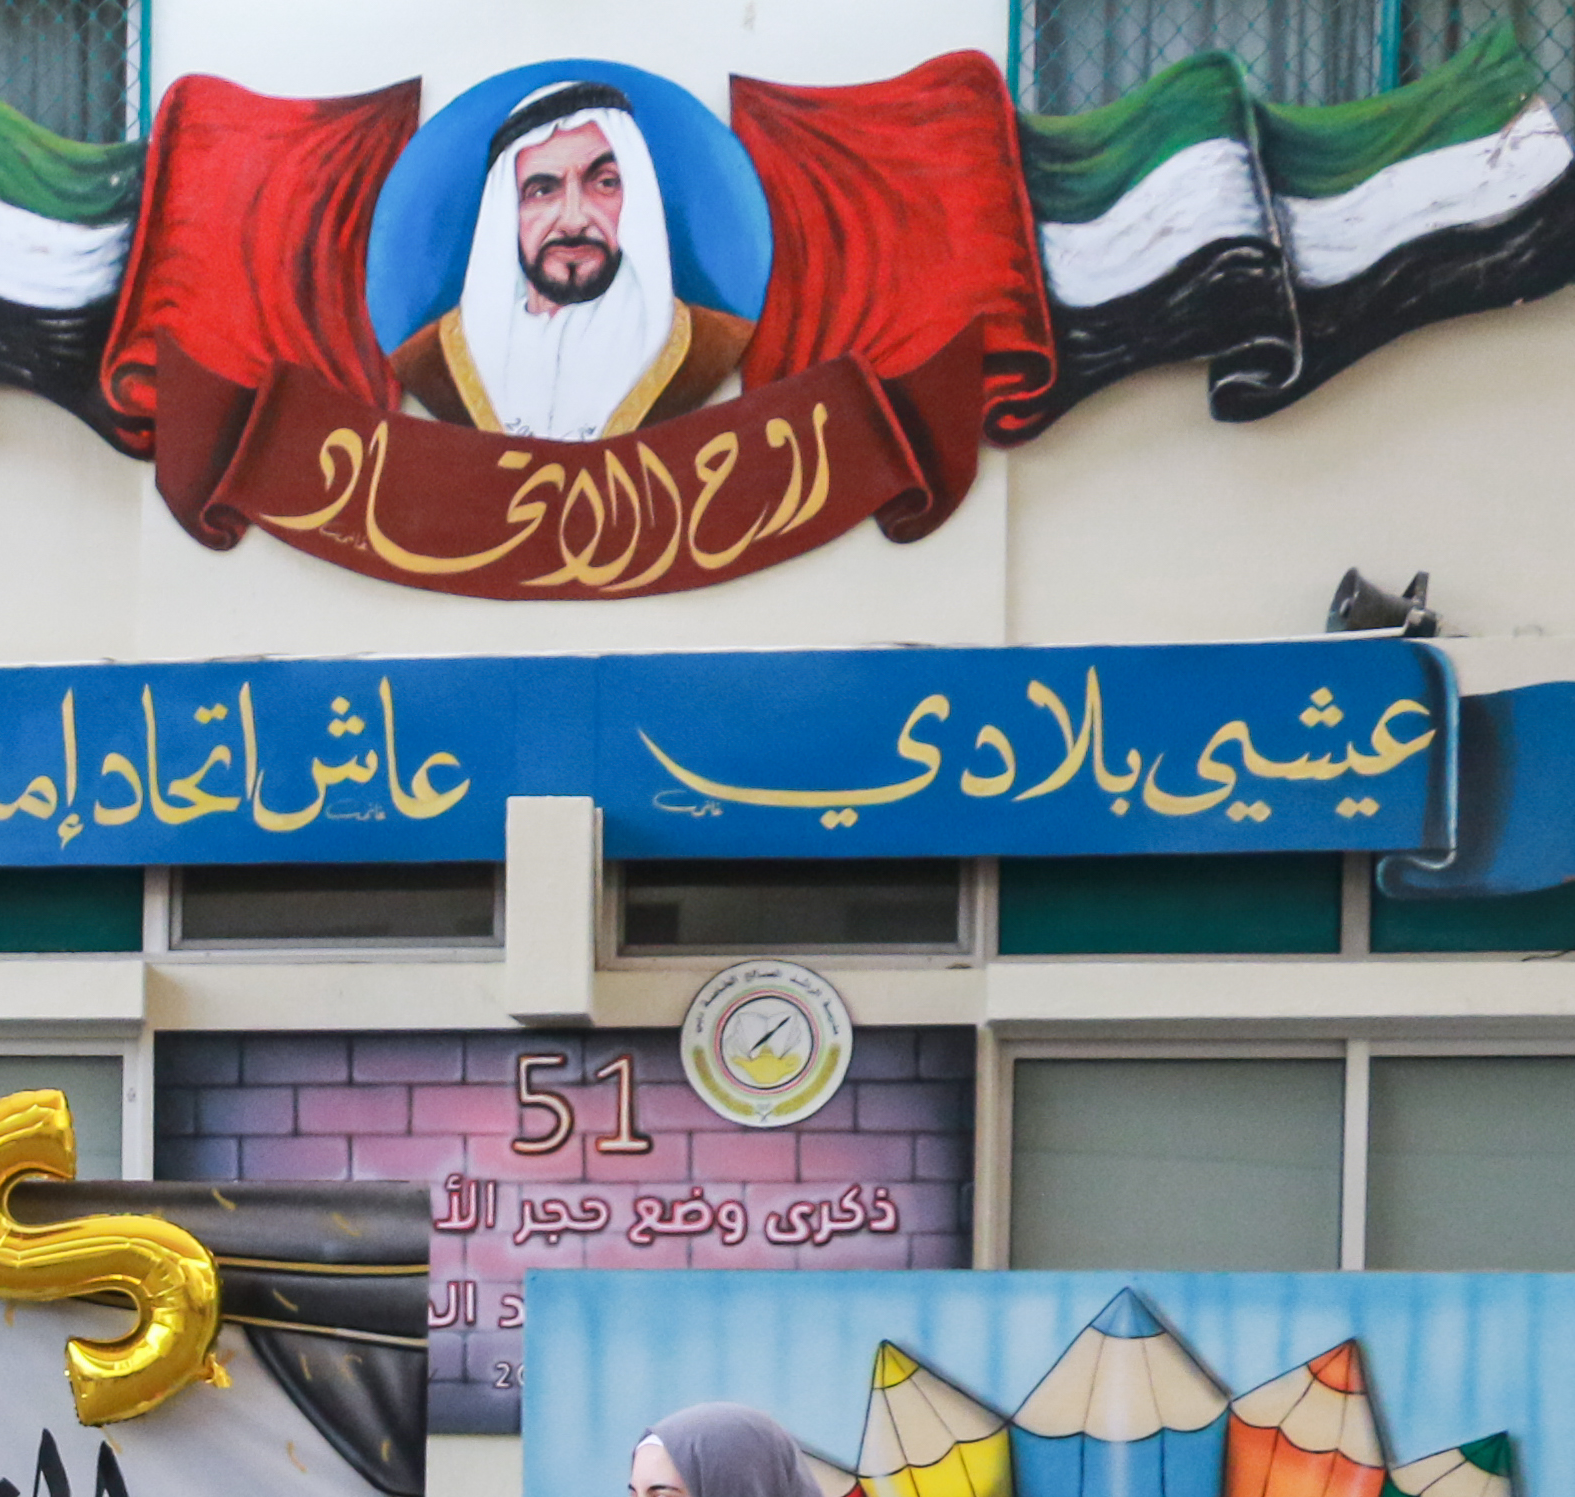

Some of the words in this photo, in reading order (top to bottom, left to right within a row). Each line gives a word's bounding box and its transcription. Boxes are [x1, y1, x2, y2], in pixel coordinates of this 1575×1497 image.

[259, 419, 683, 592] الاتحاد
[690, 402, 830, 570] روح
[94, 681, 255, 827] اتحاد
[254, 676, 471, 833] عاش
[638, 664, 1142, 829] بلادي
[1142, 686, 1437, 822] عيشي
[511, 1051, 653, 1157] 51
[433, 1172, 499, 1232] الأ
[512, 1198, 611, 1246] حجر
[628, 1185, 748, 1245] وضع
[764, 1184, 899, 1245] ذكرى
